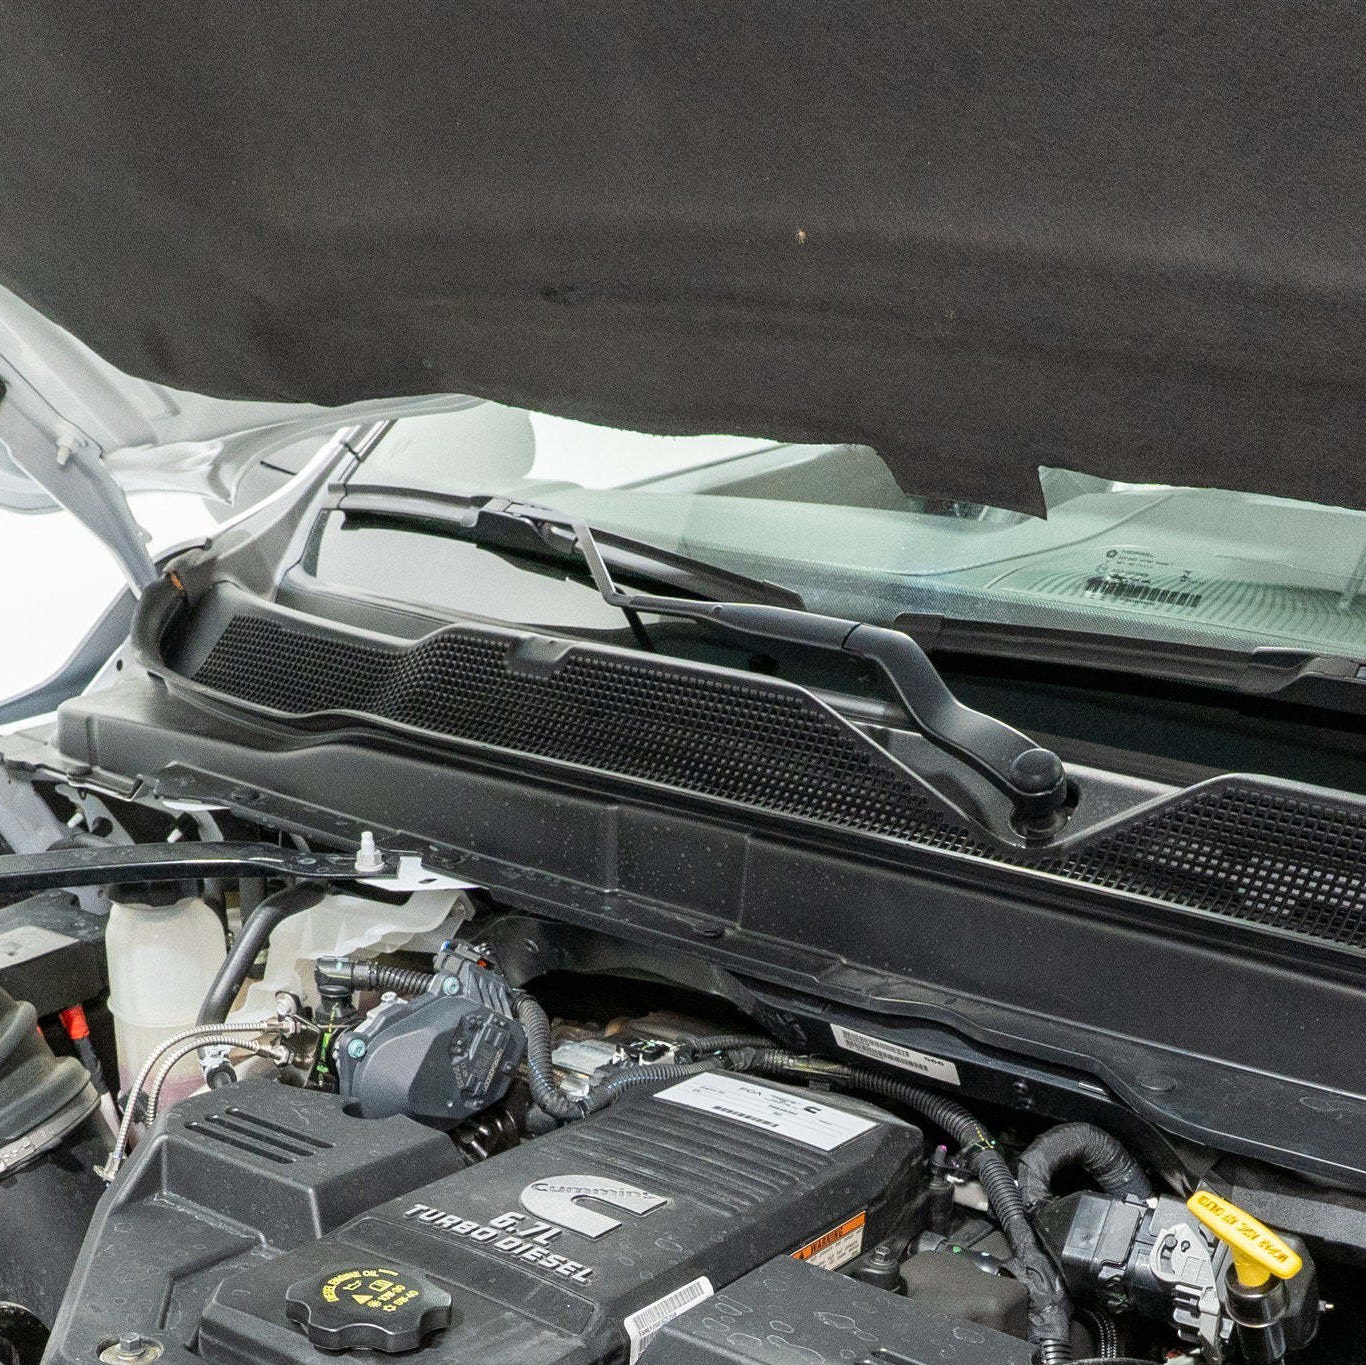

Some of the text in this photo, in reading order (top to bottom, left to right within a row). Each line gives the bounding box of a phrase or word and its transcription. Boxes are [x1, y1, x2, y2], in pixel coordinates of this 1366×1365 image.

[531, 1183, 656, 1199] Cummins
[490, 1211, 562, 1247] 6.7L
[405, 1203, 593, 1284] TURBO DIESEL
[327, 1270, 362, 1285] ENGINE
